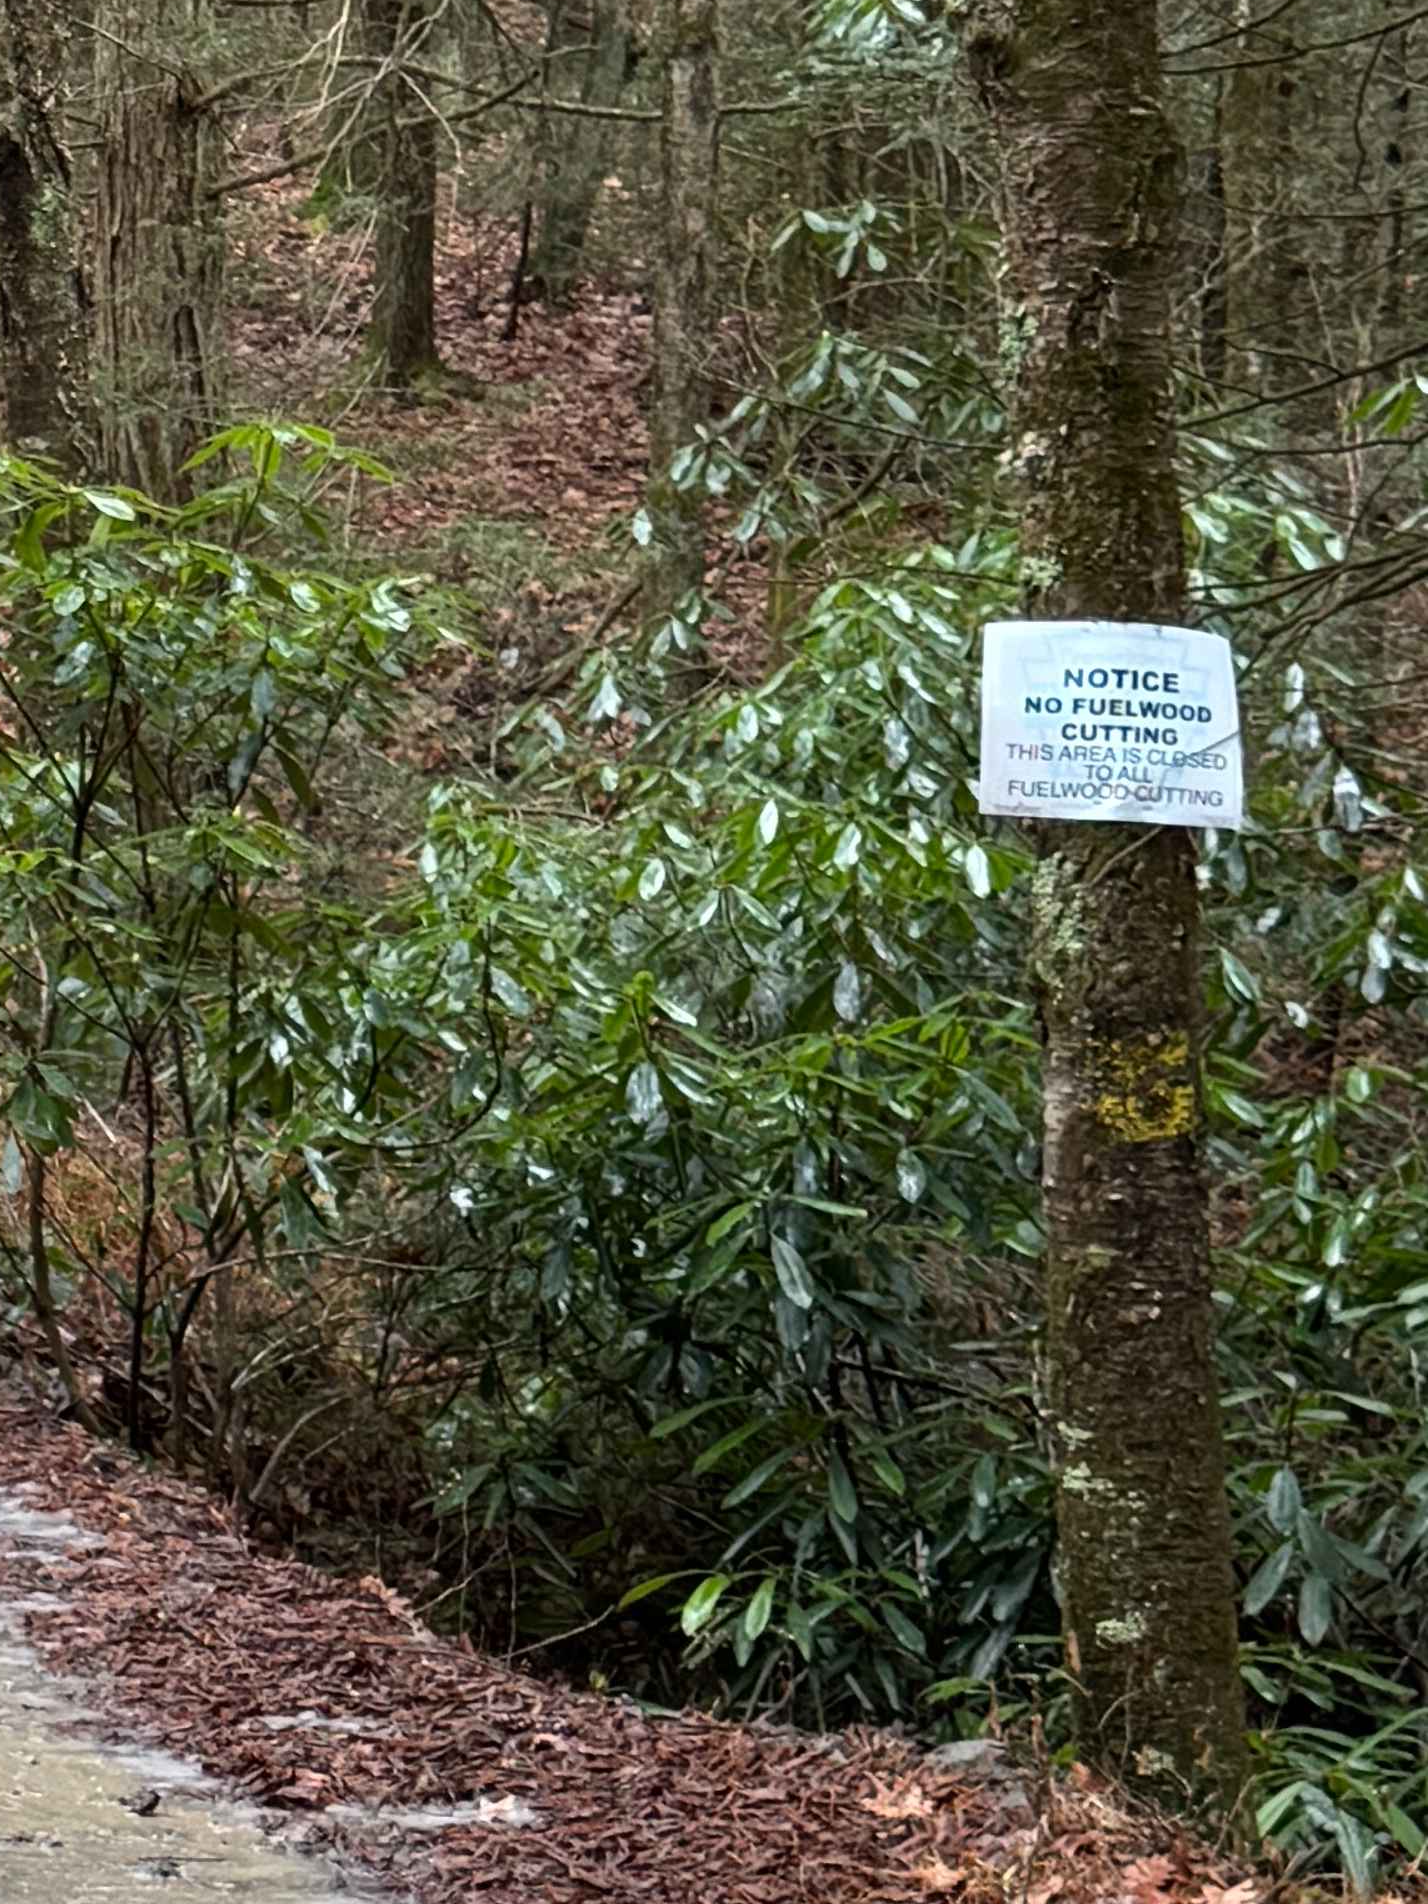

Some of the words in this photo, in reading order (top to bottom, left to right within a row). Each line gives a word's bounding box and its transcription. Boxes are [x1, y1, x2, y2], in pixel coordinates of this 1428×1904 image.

[1063, 668, 1180, 693] NOTICE
[1024, 697, 1063, 714] NO
[1072, 698, 1213, 723] FUELWOOD
[1061, 724, 1179, 746] CUTTING
[1006, 744, 1054, 762] THIS
[1058, 745, 1117, 764] AREA
[1123, 748, 1142, 765] IS
[1146, 749, 1228, 771] CLOSED
[1085, 765, 1113, 781] TO
[1118, 766, 1154, 784] ALL
[1007, 780, 1132, 801] FUELWOOD
[1134, 784, 1224, 807] CUTTING
